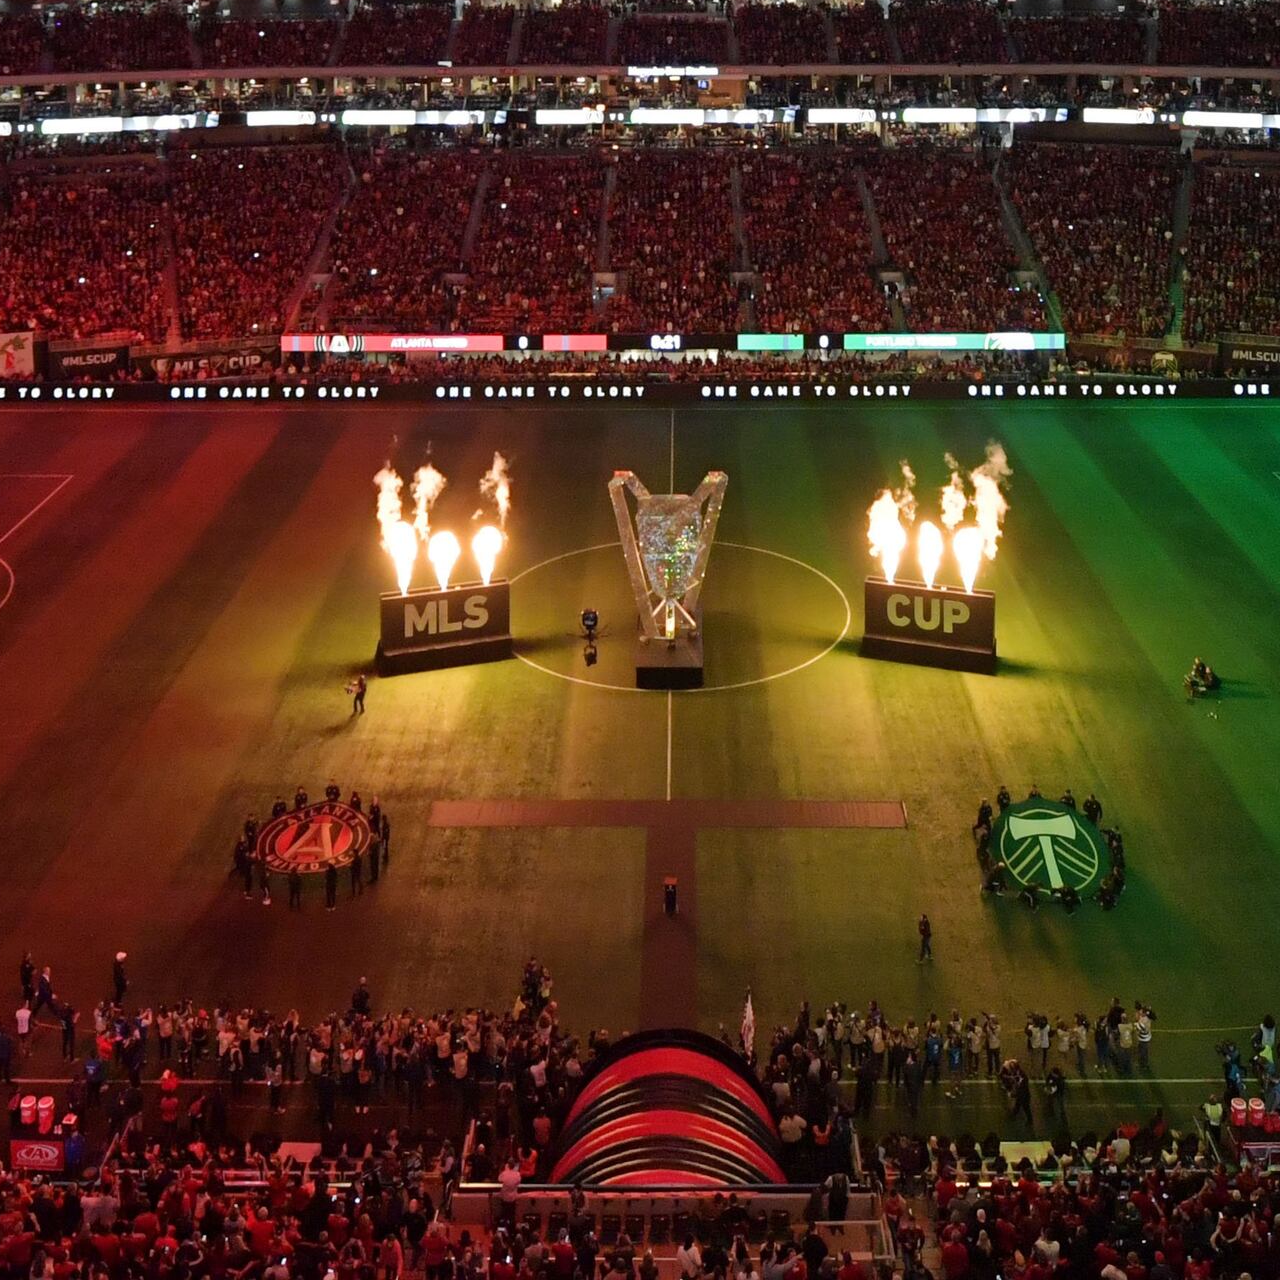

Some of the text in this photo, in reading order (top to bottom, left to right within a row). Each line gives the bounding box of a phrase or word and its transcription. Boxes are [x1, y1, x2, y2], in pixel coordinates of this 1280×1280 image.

[62, 353, 117, 367] #MLSCUP
[228, 355, 261, 369] CUP
[18, 387, 41, 399] TO
[53, 387, 115, 398] GLORY
[170, 386, 379, 399] ONE GAME TO GLORY
[435, 386, 645, 398] ONE GAME TO GLORY
[701, 385, 911, 397] ONE GAME TO GLORY
[968, 384, 1177, 396] ONE GAME TO GLORY
[1234, 383, 1270, 395] ONE
[403, 597, 490, 638] MLS
[886, 595, 970, 634] CUP
